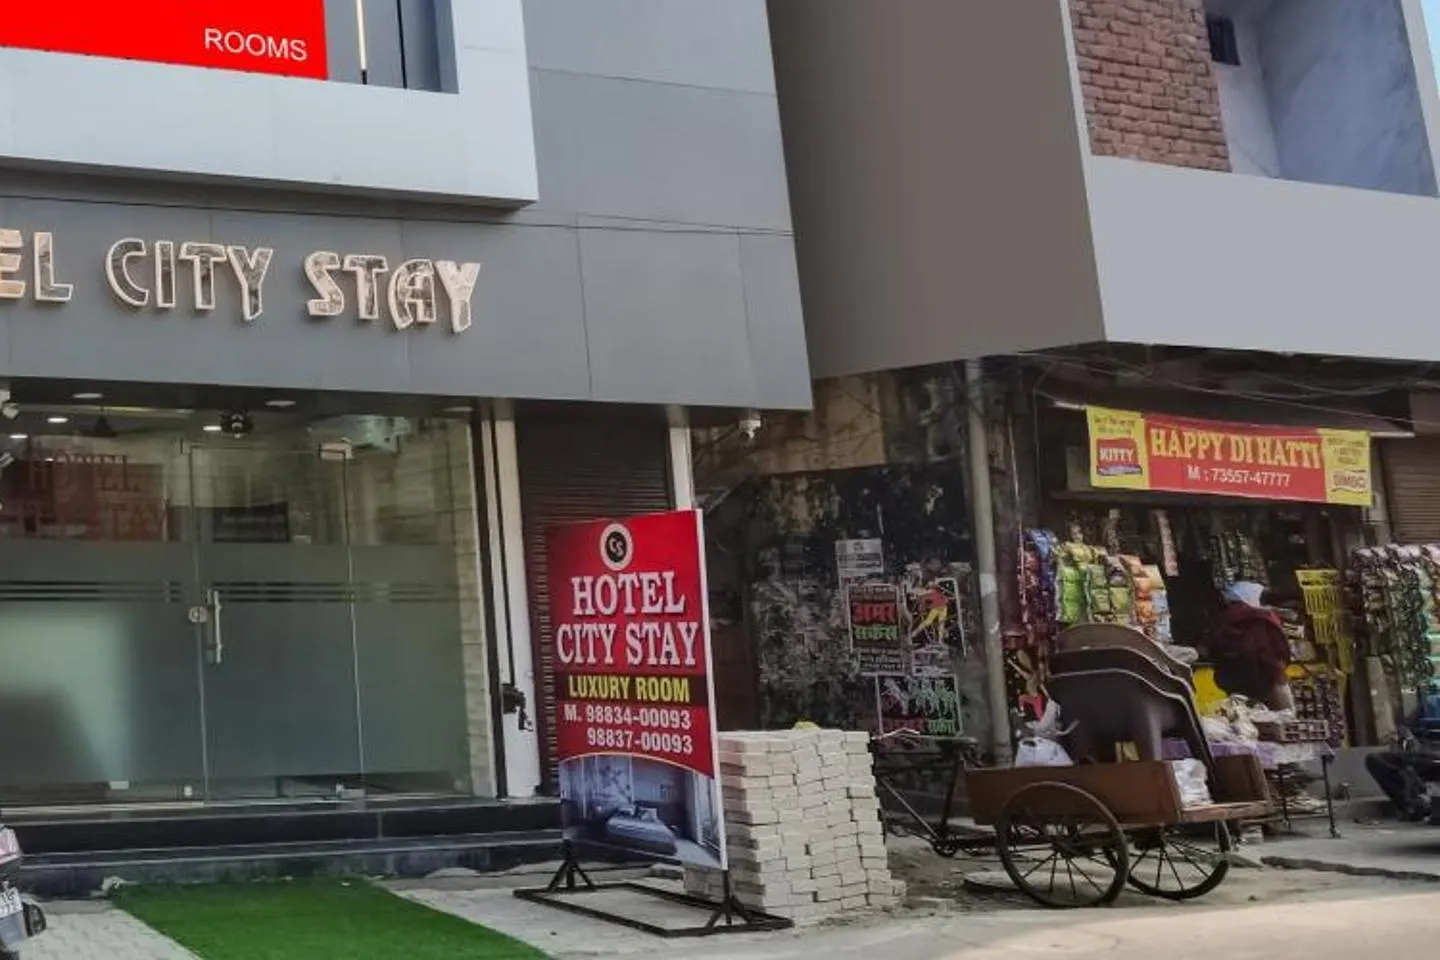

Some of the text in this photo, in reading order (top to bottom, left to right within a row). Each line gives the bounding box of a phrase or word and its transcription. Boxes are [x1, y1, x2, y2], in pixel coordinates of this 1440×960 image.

[203, 27, 308, 62] ROOMS
[105, 236, 274, 323] CITY
[303, 250, 482, 334] STAY
[1099, 447, 1134, 462] KITTY
[1149, 427, 1226, 462] HAPPY
[1229, 435, 1254, 463] DI
[1257, 434, 1322, 469] HATTI
[571, 571, 685, 616] HOTEL
[557, 622, 699, 666] CITY STAY
[568, 675, 691, 703] LUXURY ROOM
[564, 704, 692, 730] M. 98834-00093
[587, 727, 693, 754] 98837-00093
